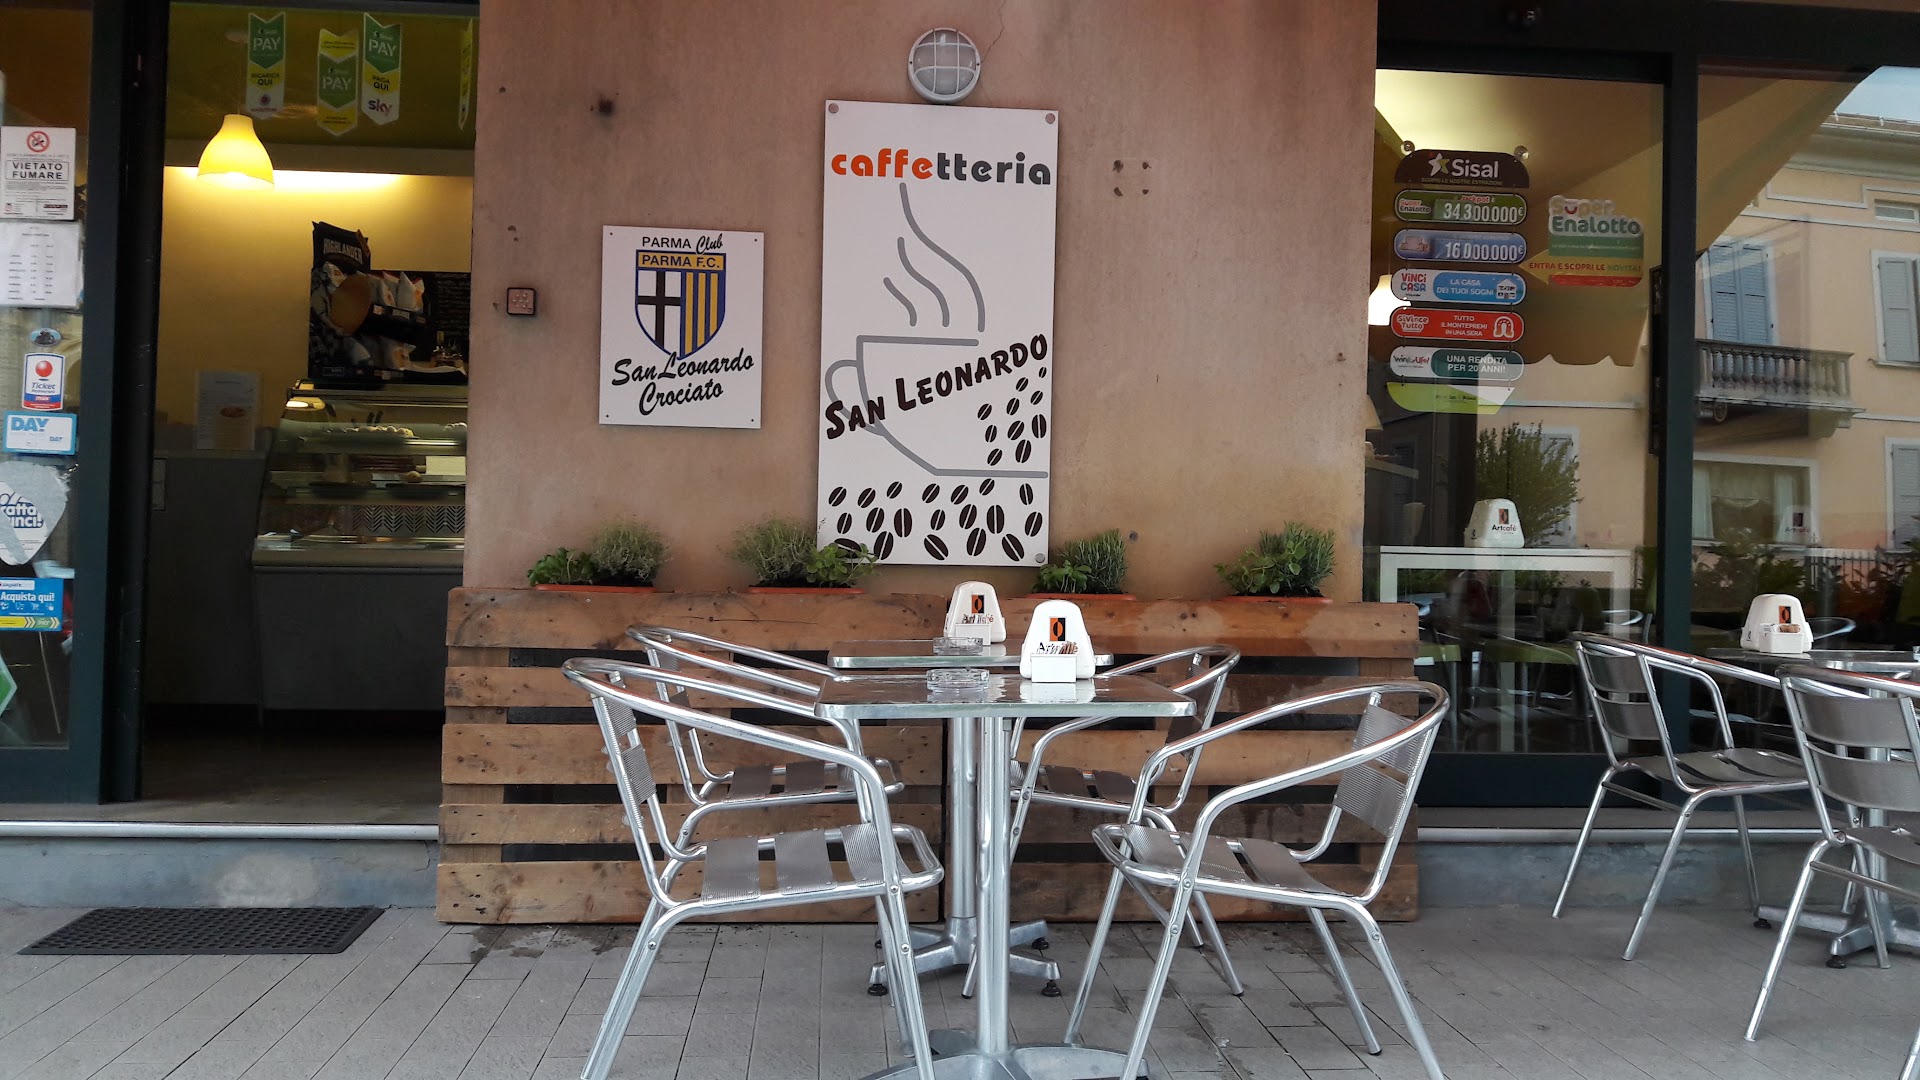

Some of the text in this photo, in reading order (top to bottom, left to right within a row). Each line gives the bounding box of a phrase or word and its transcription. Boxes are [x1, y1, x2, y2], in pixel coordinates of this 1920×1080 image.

[253, 37, 281, 50] PAY
[369, 38, 397, 57] PAY
[257, 78, 273, 86] QUI
[322, 76, 352, 91] PAY
[373, 81, 389, 91] QUI
[368, 99, 393, 117] sky
[12, 162, 63, 171] VIETATO
[831, 148, 1051, 186] caffetteria
[1451, 158, 1499, 179] Sisal
[12, 171, 63, 179] FUMARE
[1552, 215, 1641, 235] Enalotto
[323, 237, 363, 265] HIGHLANDER
[642, 233, 723, 255] PARMA Club
[641, 254, 720, 268] PARMA F.C.
[1529, 262, 1556, 270] ENTRA
[1557, 262, 1563, 270] E
[1564, 263, 1595, 271] SCOPRI
[1596, 263, 1606, 271] LE
[1400, 282, 1427, 292] CASA
[1436, 286, 1449, 294] DEI
[1469, 288, 1494, 296] SOGNI
[611, 347, 754, 386] San Leonardo
[1446, 355, 1508, 365] UNA RENDITA
[1447, 363, 1506, 373] PER 20 ANNI!
[825, 333, 1048, 440] SAN LEONARDO
[639, 378, 723, 416] Crociato
[10, 416, 49, 432] DAY
[1491, 524, 1517, 532] Artcafé
[0, 591, 55, 604] Acquista qui!
